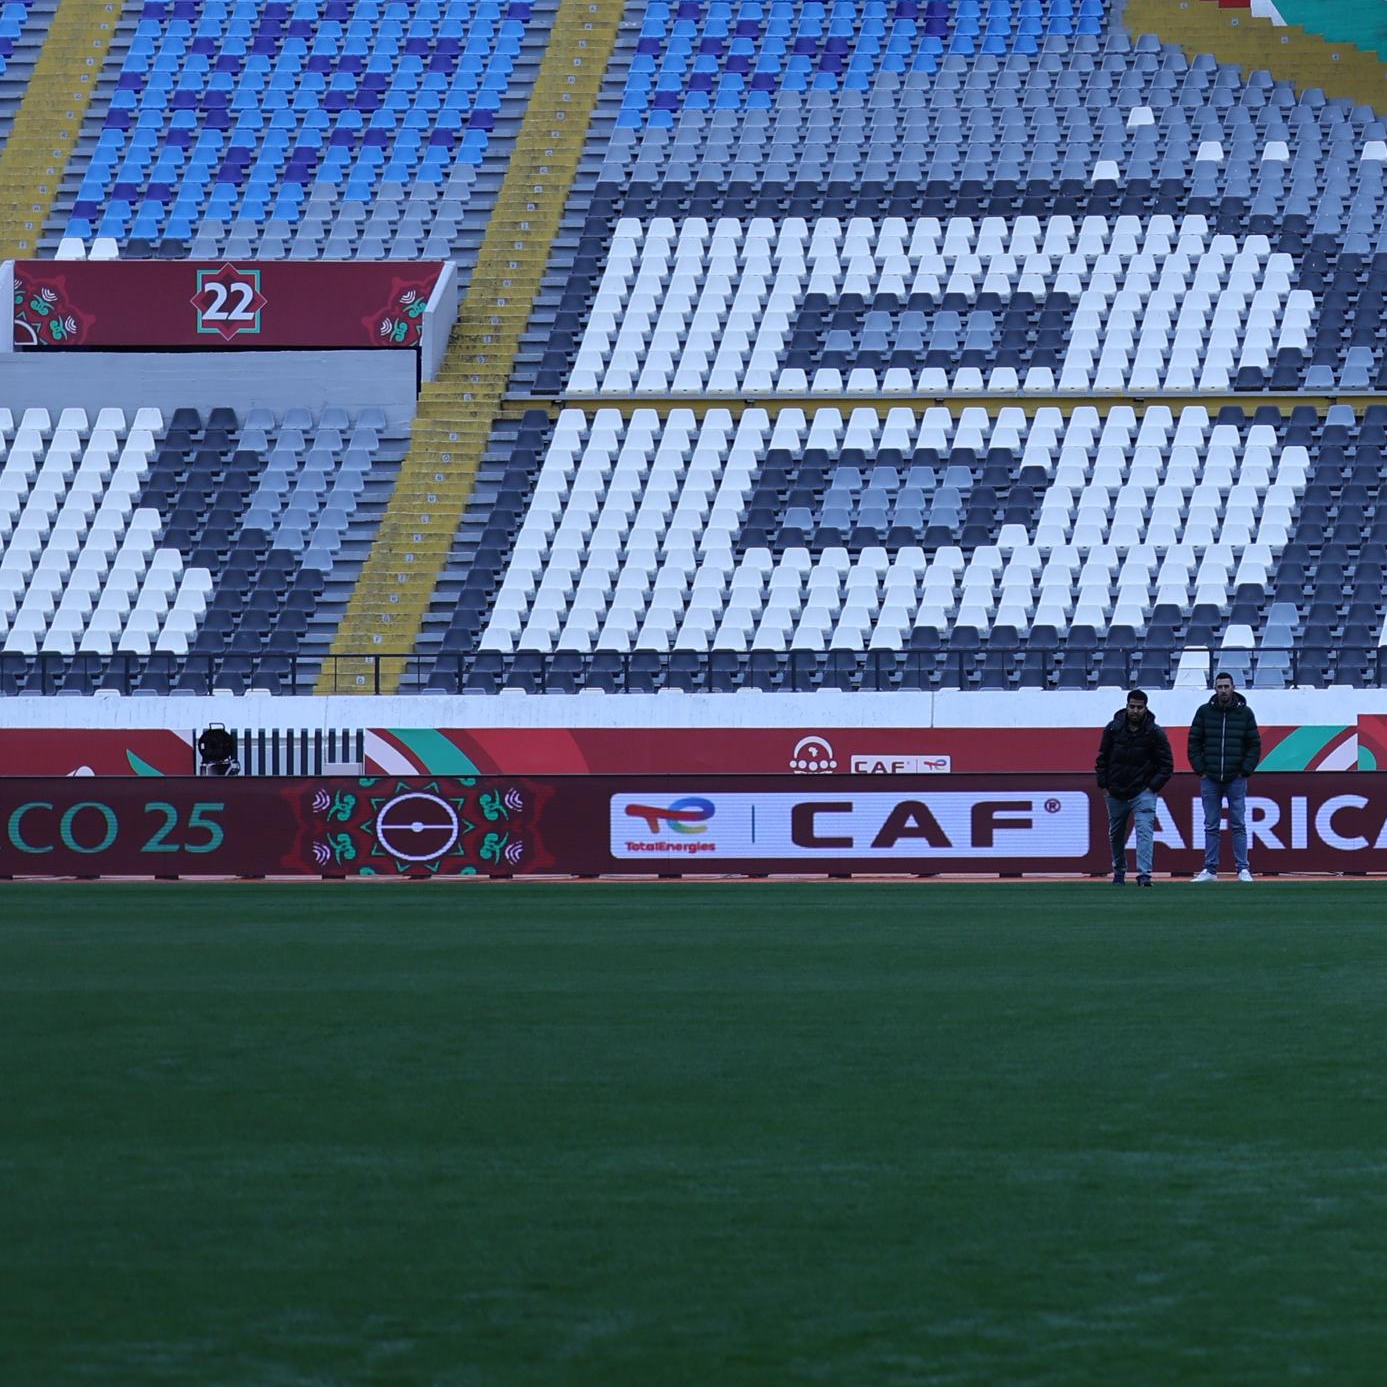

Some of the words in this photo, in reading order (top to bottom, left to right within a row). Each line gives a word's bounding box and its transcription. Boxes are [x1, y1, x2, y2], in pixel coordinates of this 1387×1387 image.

[202, 282, 254, 320] 22
[140, 802, 225, 853] 25
[625, 841, 716, 854] TotalEnergies
